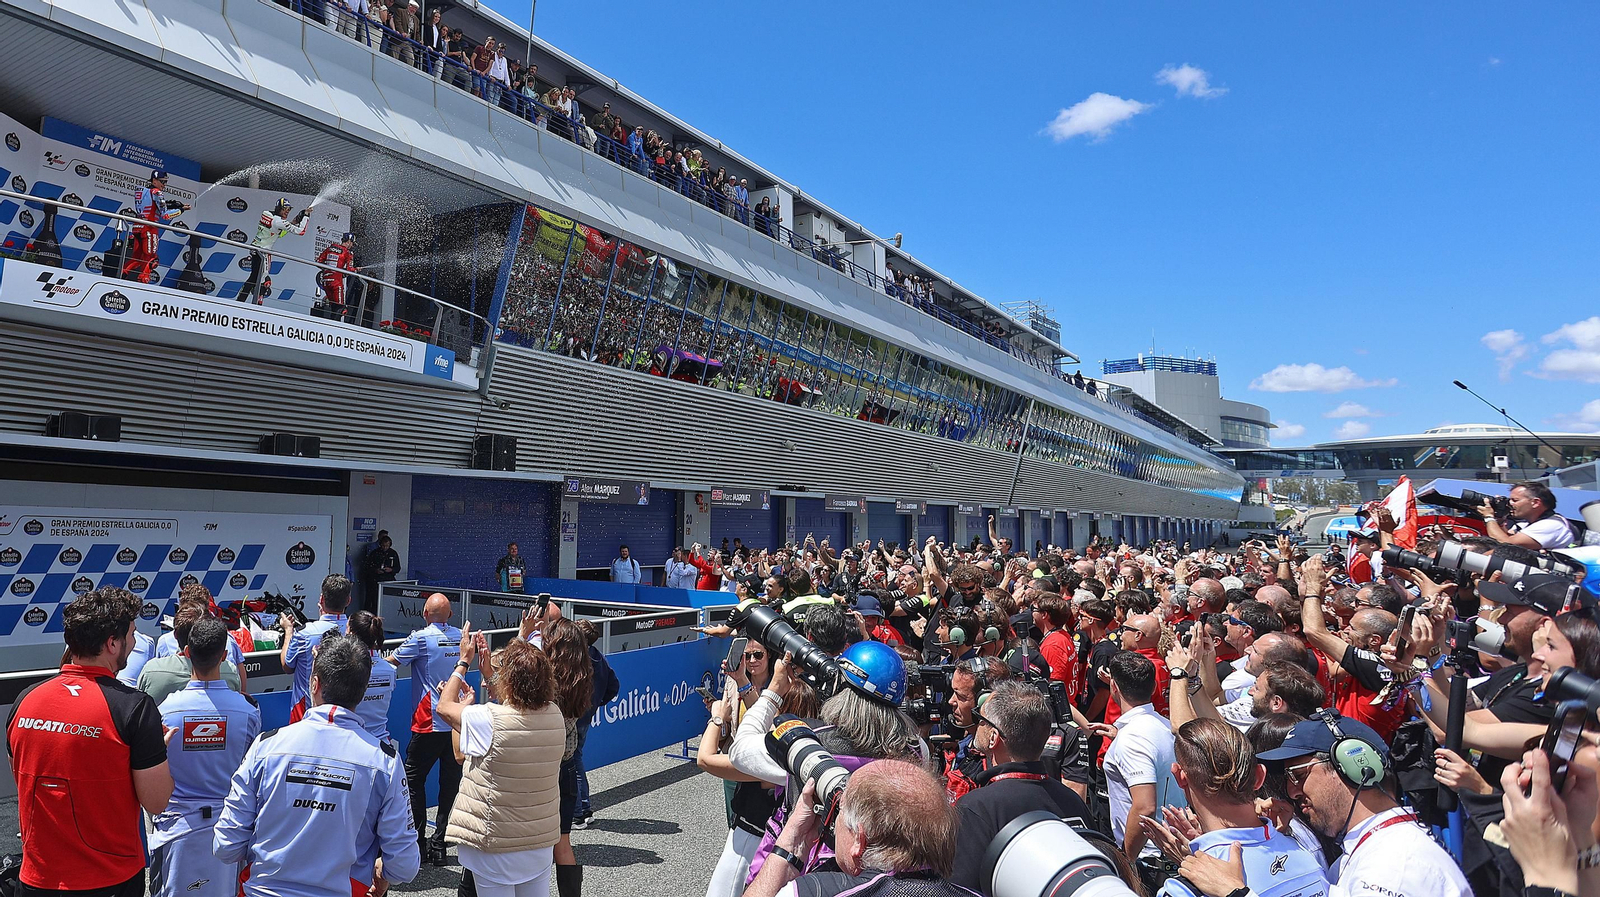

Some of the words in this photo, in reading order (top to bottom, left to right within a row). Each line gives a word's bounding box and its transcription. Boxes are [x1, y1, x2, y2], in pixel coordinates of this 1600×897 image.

[87, 134, 122, 155] FIM
[96, 168, 112, 178] GRAN
[113, 172, 135, 185] PREMIO
[104, 177, 126, 189] ESPAÑA
[141, 301, 180, 319] GRAN
[181, 307, 229, 327] PREMIO
[231, 316, 284, 338] ESTRELLA
[287, 327, 324, 346] GALICIA
[326, 334, 342, 349] 0,0
[343, 337, 354, 350] DE
[355, 341, 385, 357] ESPAÑA
[387, 349, 407, 361] 2024
[51, 519, 71, 528] GRAN
[73, 519, 100, 528] PREMIO
[102, 520, 134, 529] ESTRELLA
[135, 521, 160, 529] GALICIA
[161, 522, 172, 531] 0,0
[203, 523, 218, 531] FIM
[50, 528, 60, 537] DE
[61, 528, 89, 537] ESPAÑA
[91, 529, 109, 537] 2024
[494, 599, 536, 608] motogppremier.co
[602, 609, 626, 617] MotoGP
[635, 620, 655, 630] MotoGP
[655, 617, 676, 627] PREMIER
[604, 686, 660, 724] Galicia
[293, 798, 337, 812] DUCATI
